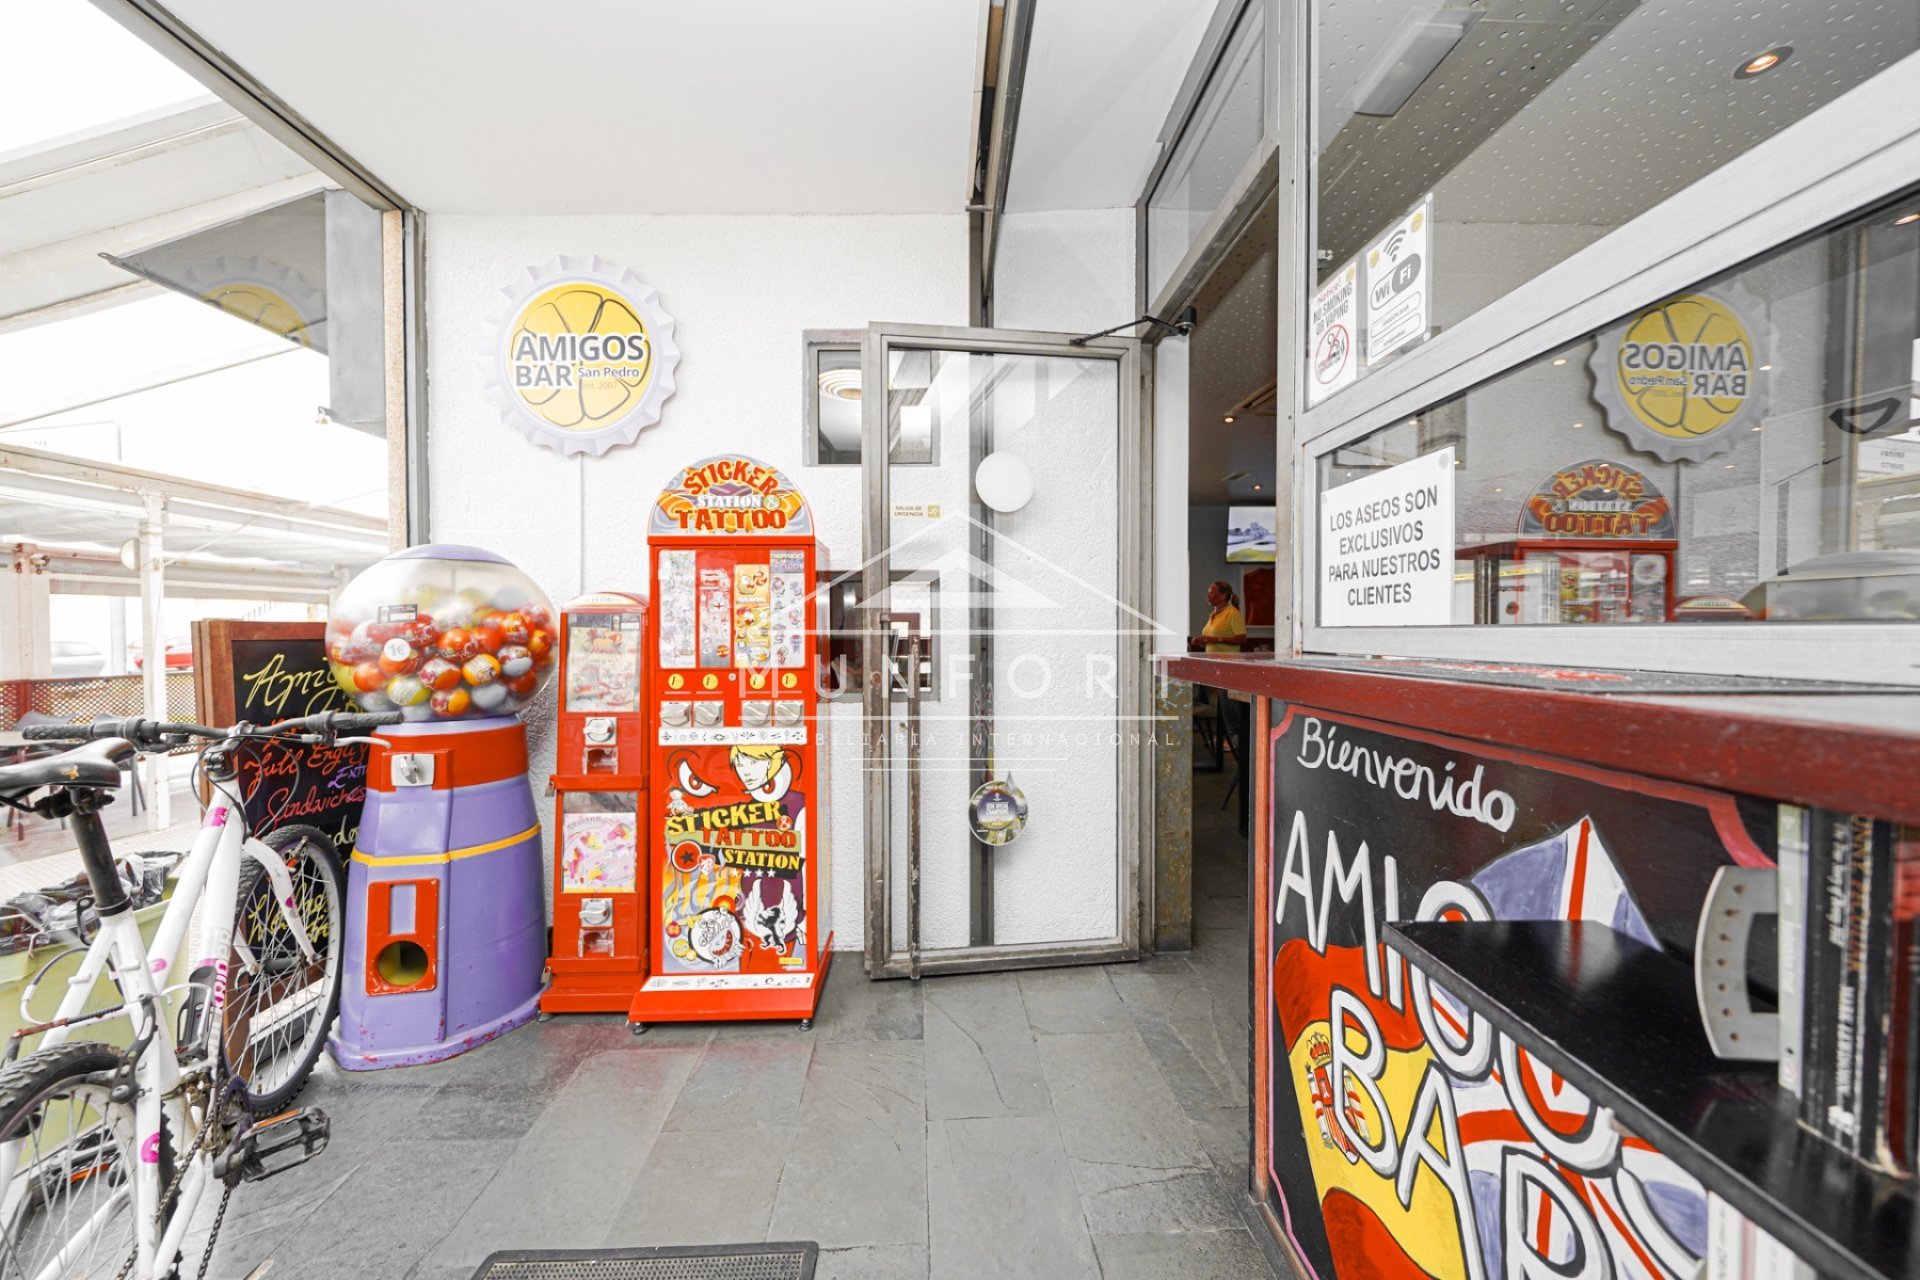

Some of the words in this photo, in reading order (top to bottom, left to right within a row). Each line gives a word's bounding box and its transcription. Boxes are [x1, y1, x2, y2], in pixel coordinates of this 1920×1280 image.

[1313, 308, 1322, 324] NO
[1323, 282, 1352, 316] SMOKING
[1316, 319, 1325, 335] OR
[1326, 300, 1348, 328] VAPING
[515, 335, 644, 361] AMIGOS
[515, 365, 573, 387] BAR
[578, 367, 600, 377] San
[603, 366, 639, 378] Pedro
[683, 460, 779, 496] STICKER
[697, 496, 763, 508] STATION
[1330, 510, 1352, 532] LOS
[1355, 496, 1400, 526] ASEOS
[1405, 485, 1437, 513] SON
[675, 509, 786, 531] TATTOO
[1340, 520, 1423, 555] EXCLUSIVOS
[1328, 561, 1359, 582] PARA
[1362, 548, 1440, 578] NUESTROS
[1347, 582, 1412, 606] CLIENTES
[1297, 717, 1517, 832] Bienvenido
[667, 801, 781, 836] STICKER
[779, 816, 789, 830] &
[700, 827, 797, 848] TATTOO
[724, 849, 800, 870] STATION
